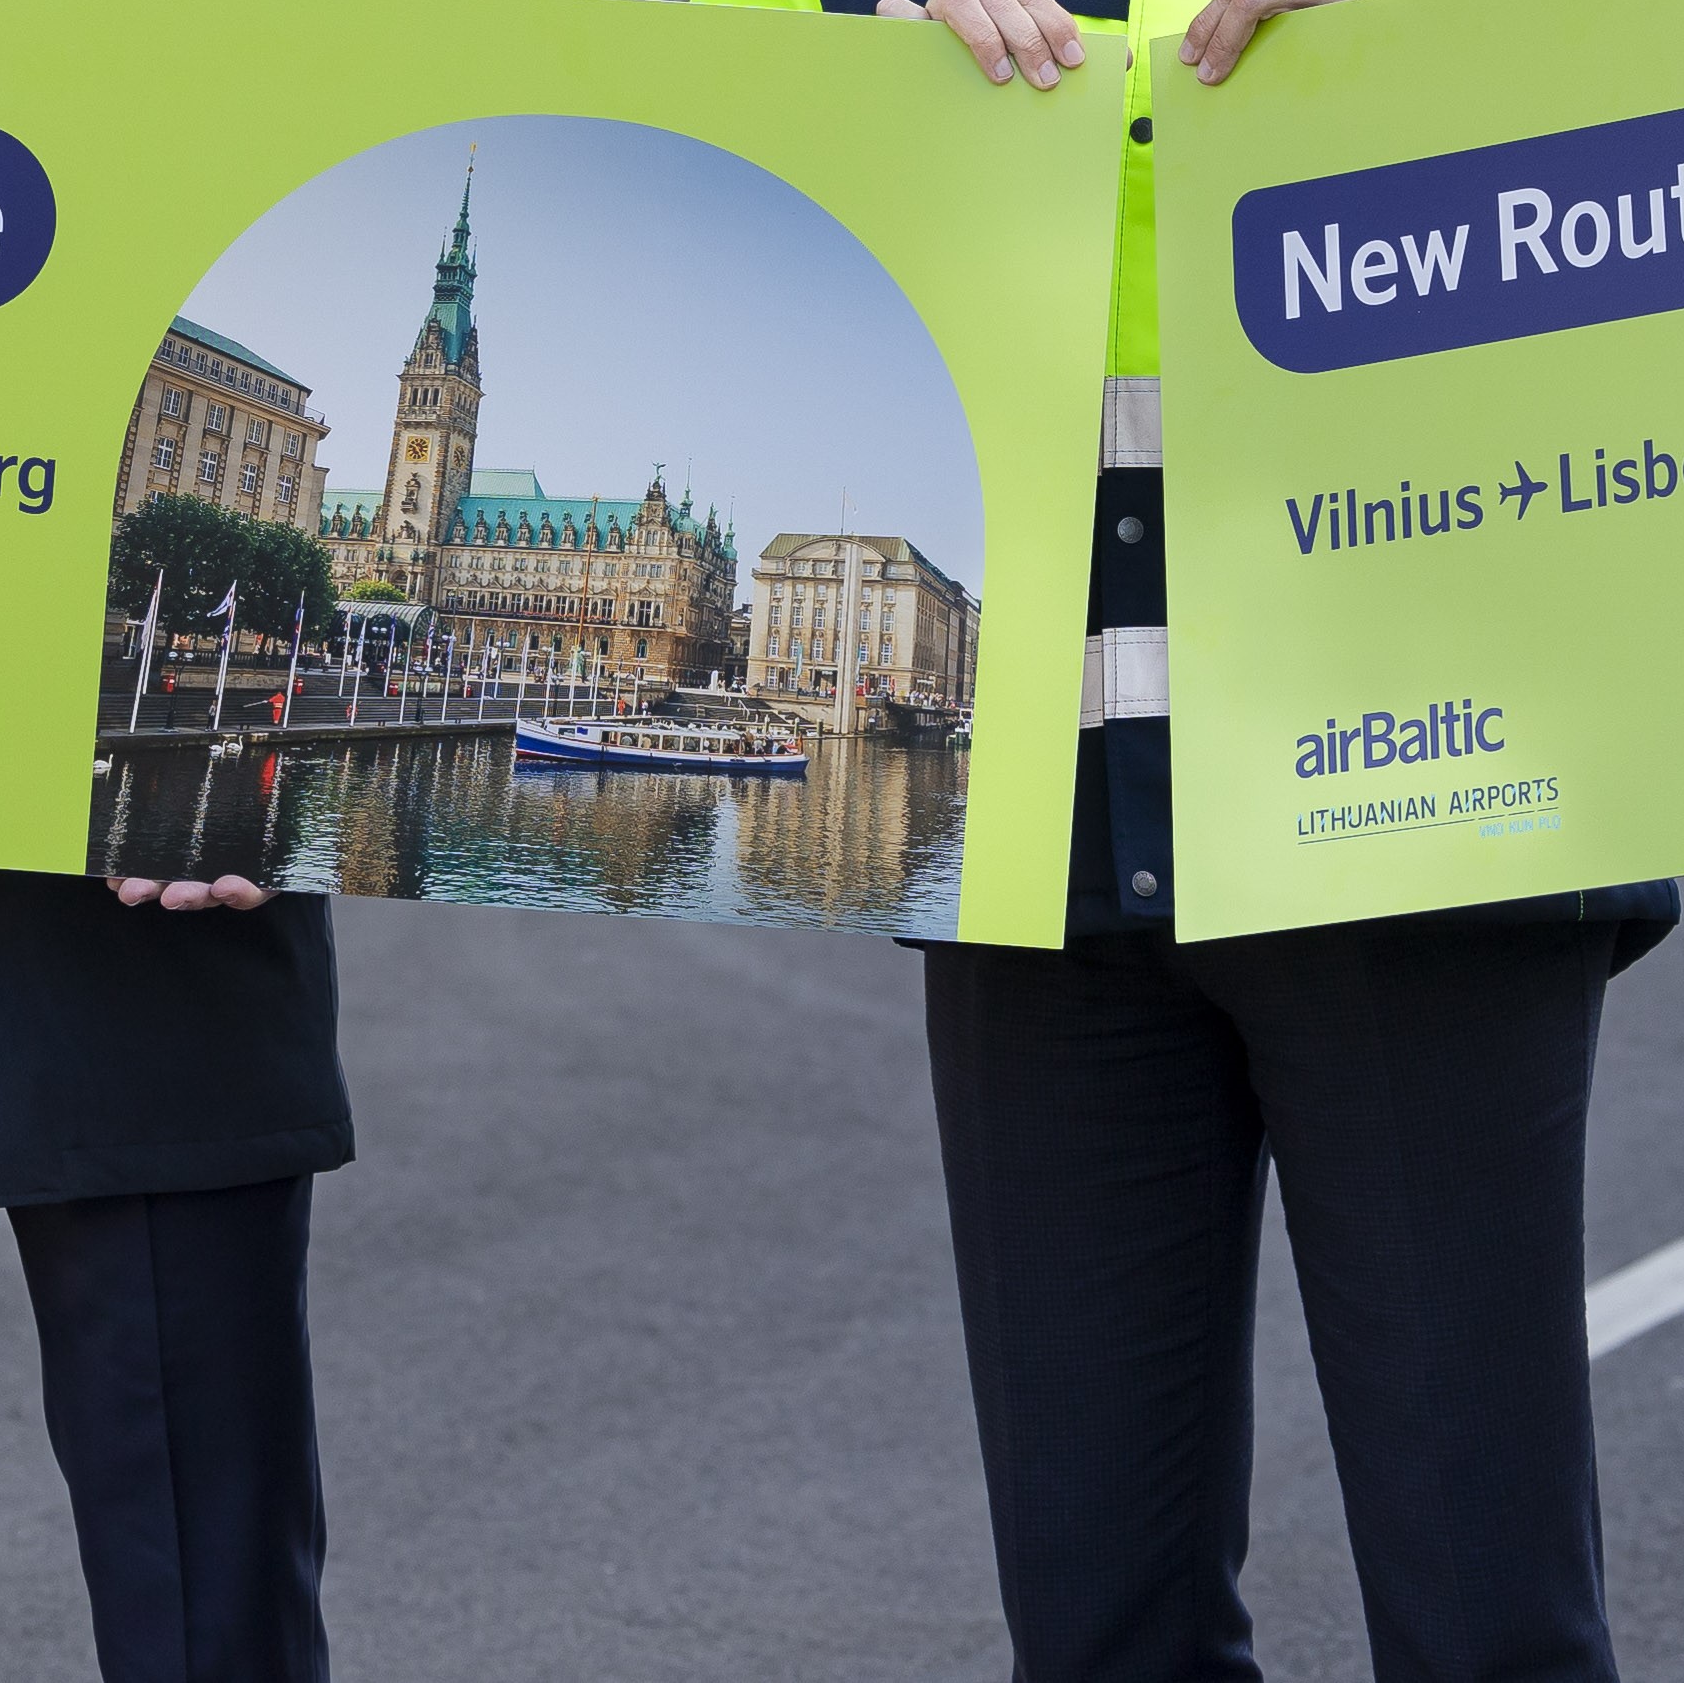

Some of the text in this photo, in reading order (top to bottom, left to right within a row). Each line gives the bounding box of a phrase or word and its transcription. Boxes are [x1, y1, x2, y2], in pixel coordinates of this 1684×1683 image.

[1282, 220, 1469, 320] New
[1286, 483, 1484, 555] Vilnius
[1295, 698, 1505, 778] airBaltic
[1298, 777, 1559, 835] LITHUANIAN AIRPORTS
